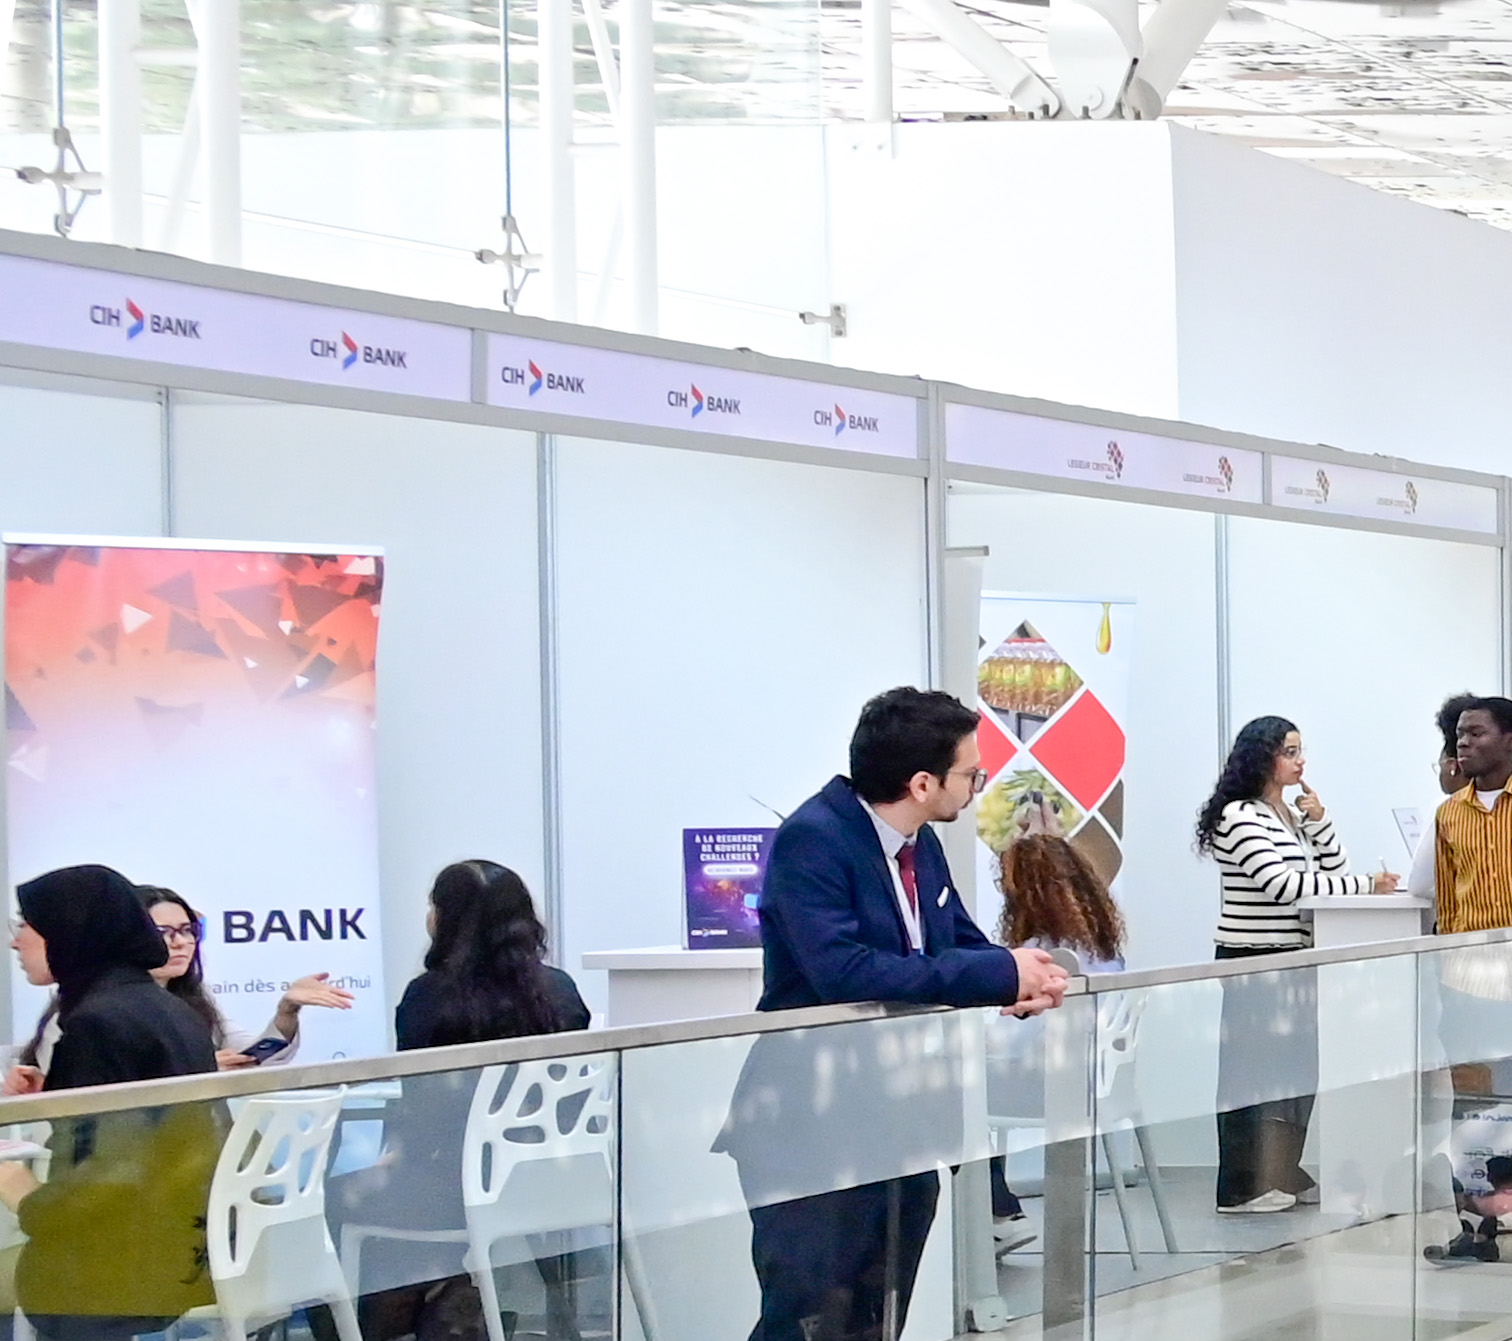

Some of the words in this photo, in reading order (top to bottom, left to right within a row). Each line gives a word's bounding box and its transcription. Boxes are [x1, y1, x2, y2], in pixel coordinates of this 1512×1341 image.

[90, 304, 120, 327] CIH
[150, 315, 200, 339] BANK
[310, 338, 337, 359] CIH
[363, 346, 407, 368] BANK
[501, 366, 525, 385] CIH
[546, 373, 585, 394] BANK
[667, 390, 688, 409] CIH
[707, 396, 741, 415] BANK
[814, 409, 832, 427] CIH
[848, 414, 879, 433] BANK
[223, 908, 367, 943] BANK
[244, 978, 275, 992] dès
